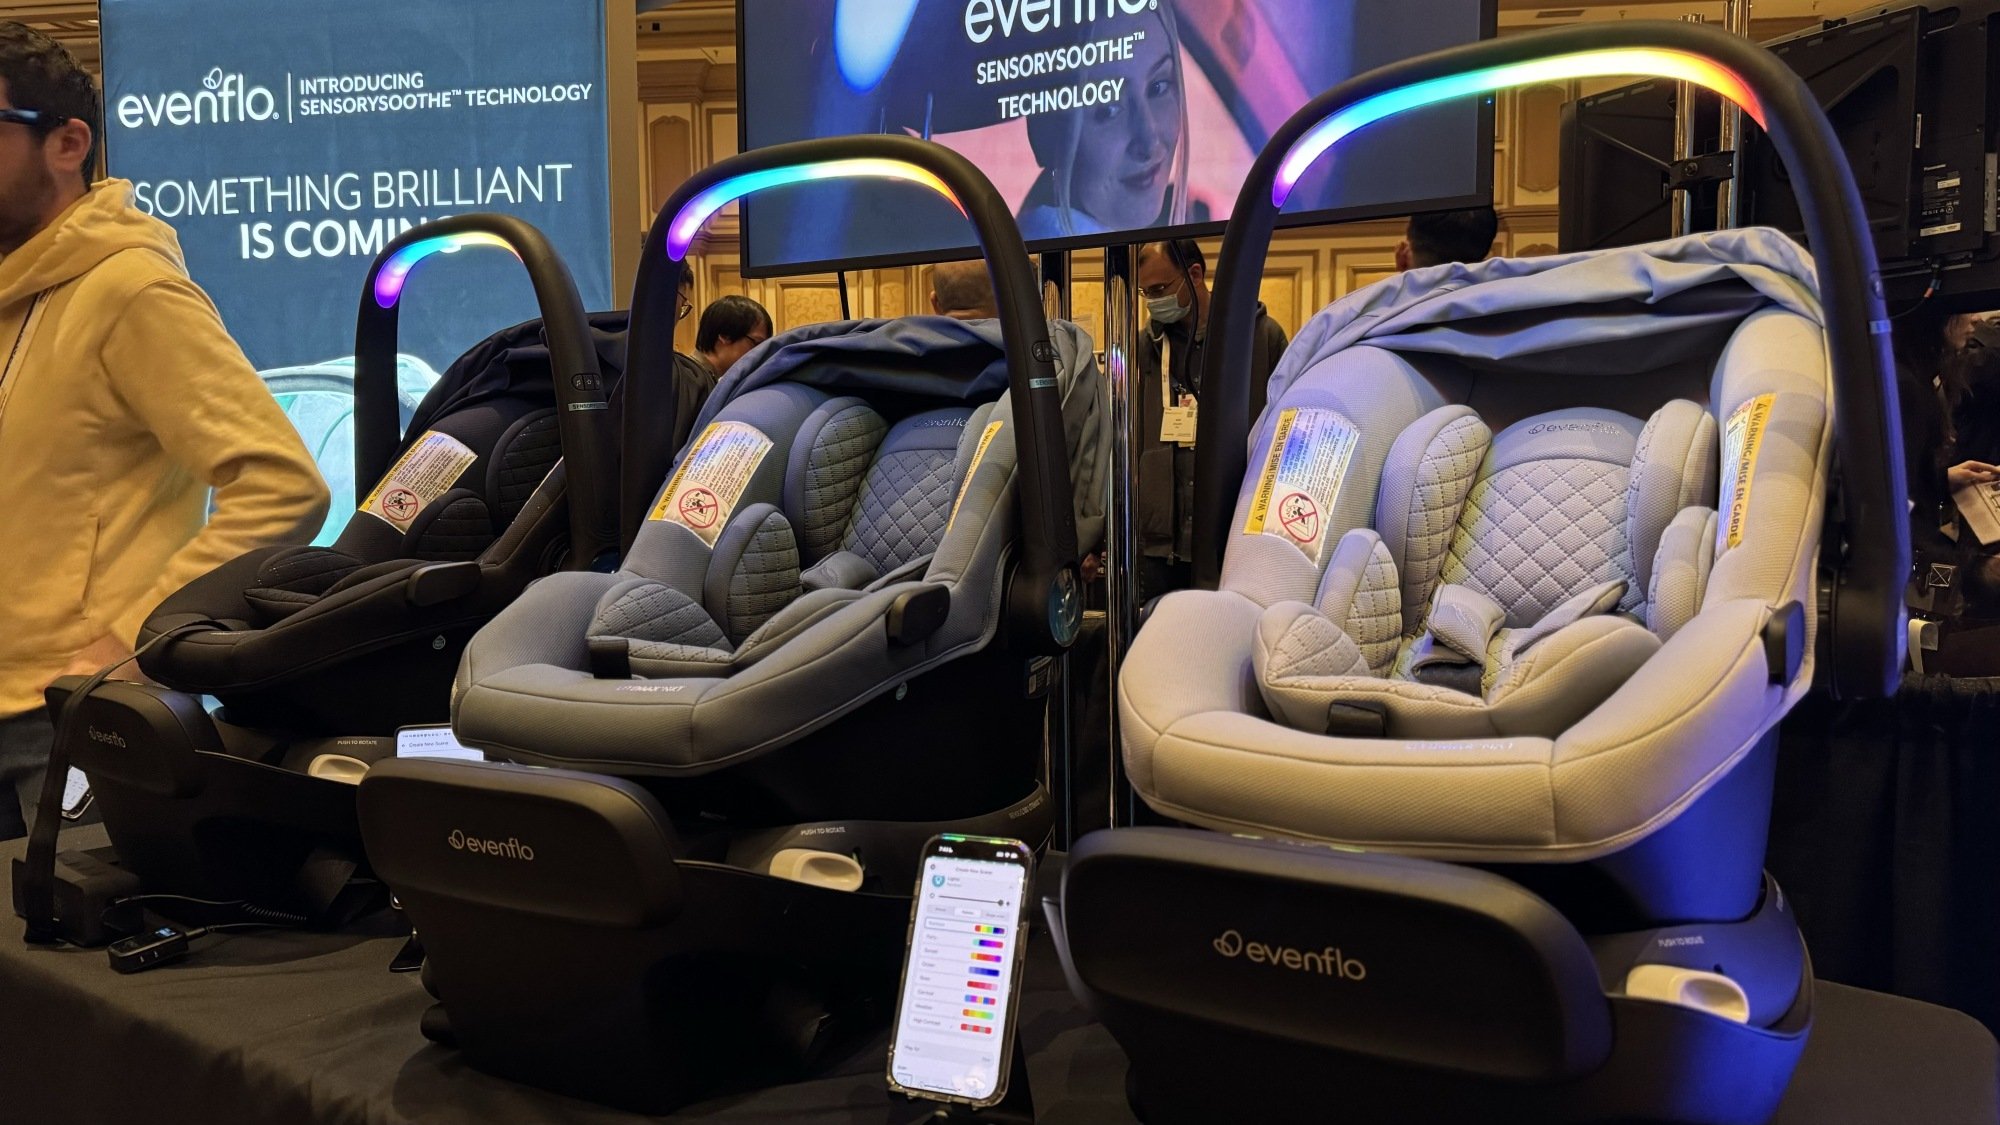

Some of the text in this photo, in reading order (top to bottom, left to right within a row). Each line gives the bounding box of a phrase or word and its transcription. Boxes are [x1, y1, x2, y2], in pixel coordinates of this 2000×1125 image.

[300, 72, 424, 95] INTRODUCING
[465, 83, 592, 107] TECHNOLOGY
[998, 78, 1124, 119] TECHNOLOGY
[135, 163, 573, 218] SOMETHING BRILLIANT
[240, 215, 462, 260] IS COMI
[1730, 504, 1742, 539] GARDE
[466, 837, 534, 861] evenflo
[1246, 941, 1366, 981] evenflo
